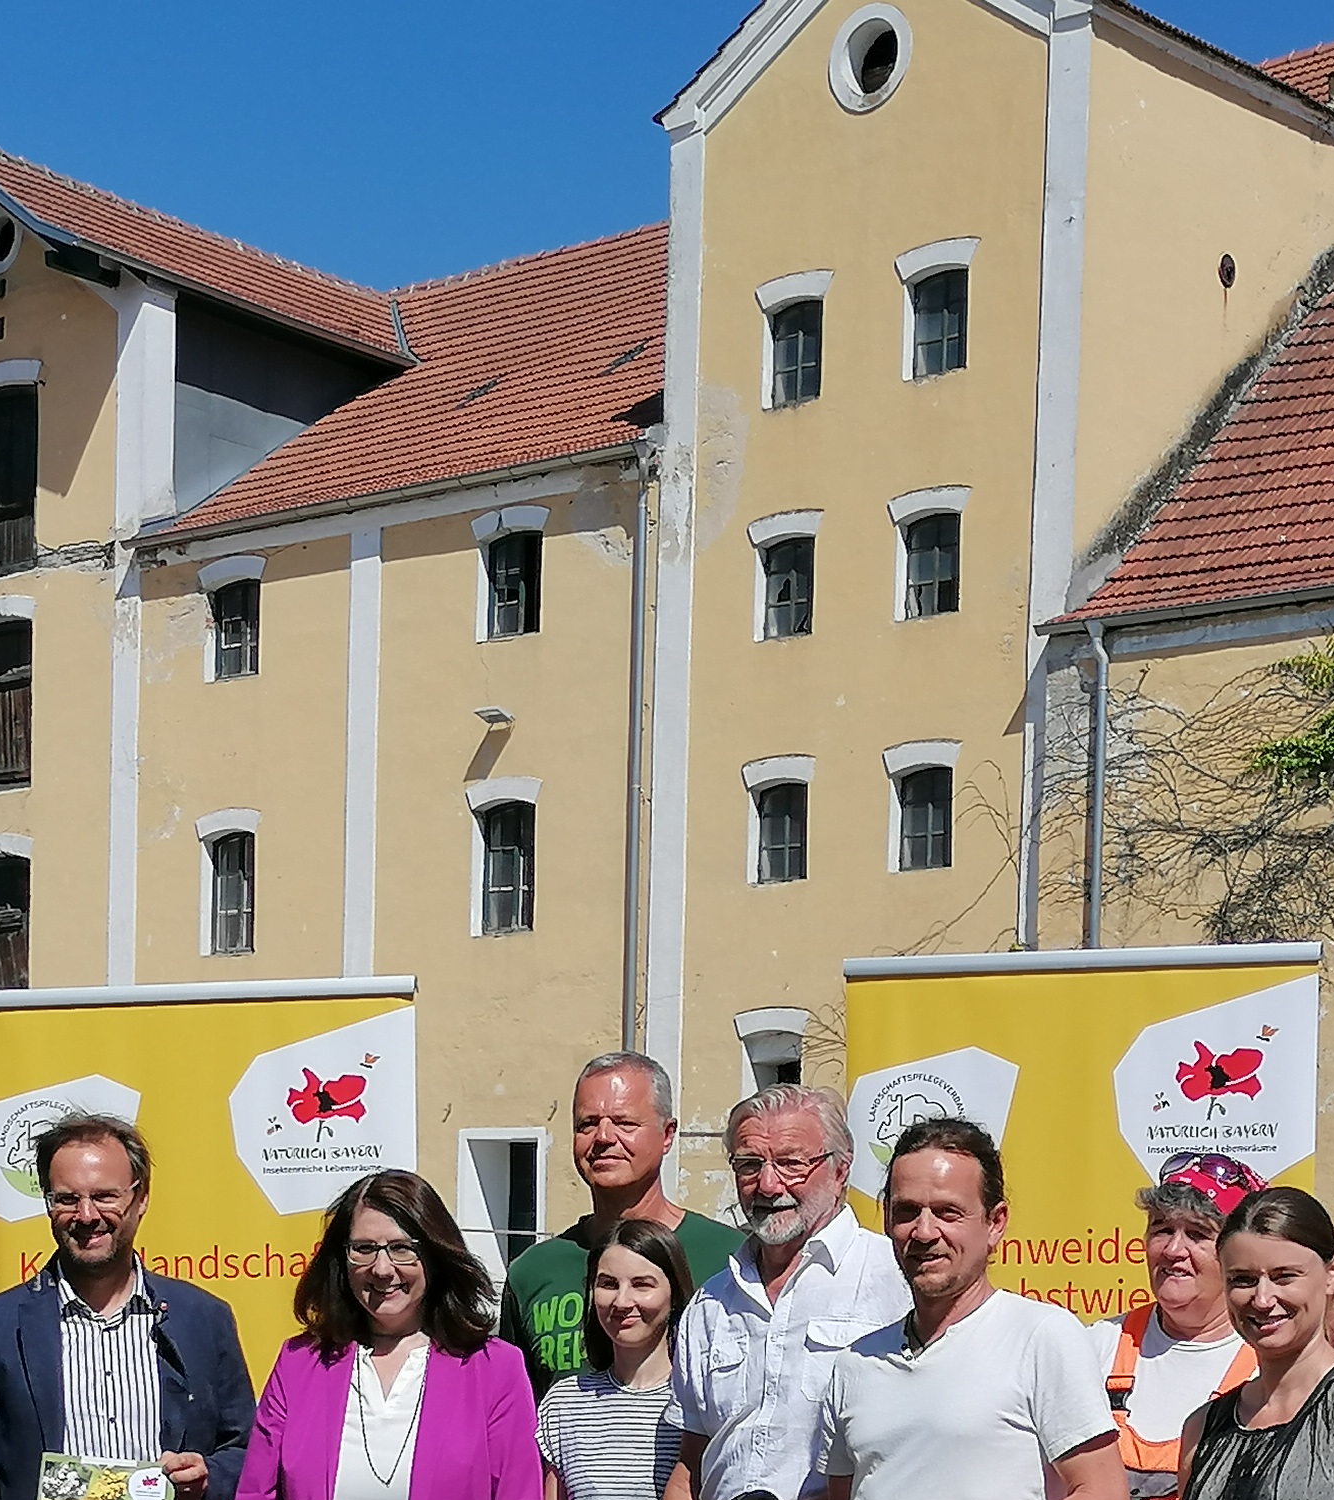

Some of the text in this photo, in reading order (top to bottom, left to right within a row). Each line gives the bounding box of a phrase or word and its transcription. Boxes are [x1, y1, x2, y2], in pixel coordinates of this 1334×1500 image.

[1147, 1122, 1279, 1140] NATÜRLICH BAYERN
[262, 1144, 383, 1161] NATÜRLICH BAYERN
[262, 1166, 323, 1175] Insektenreiche
[533, 1292, 585, 1335] WO
